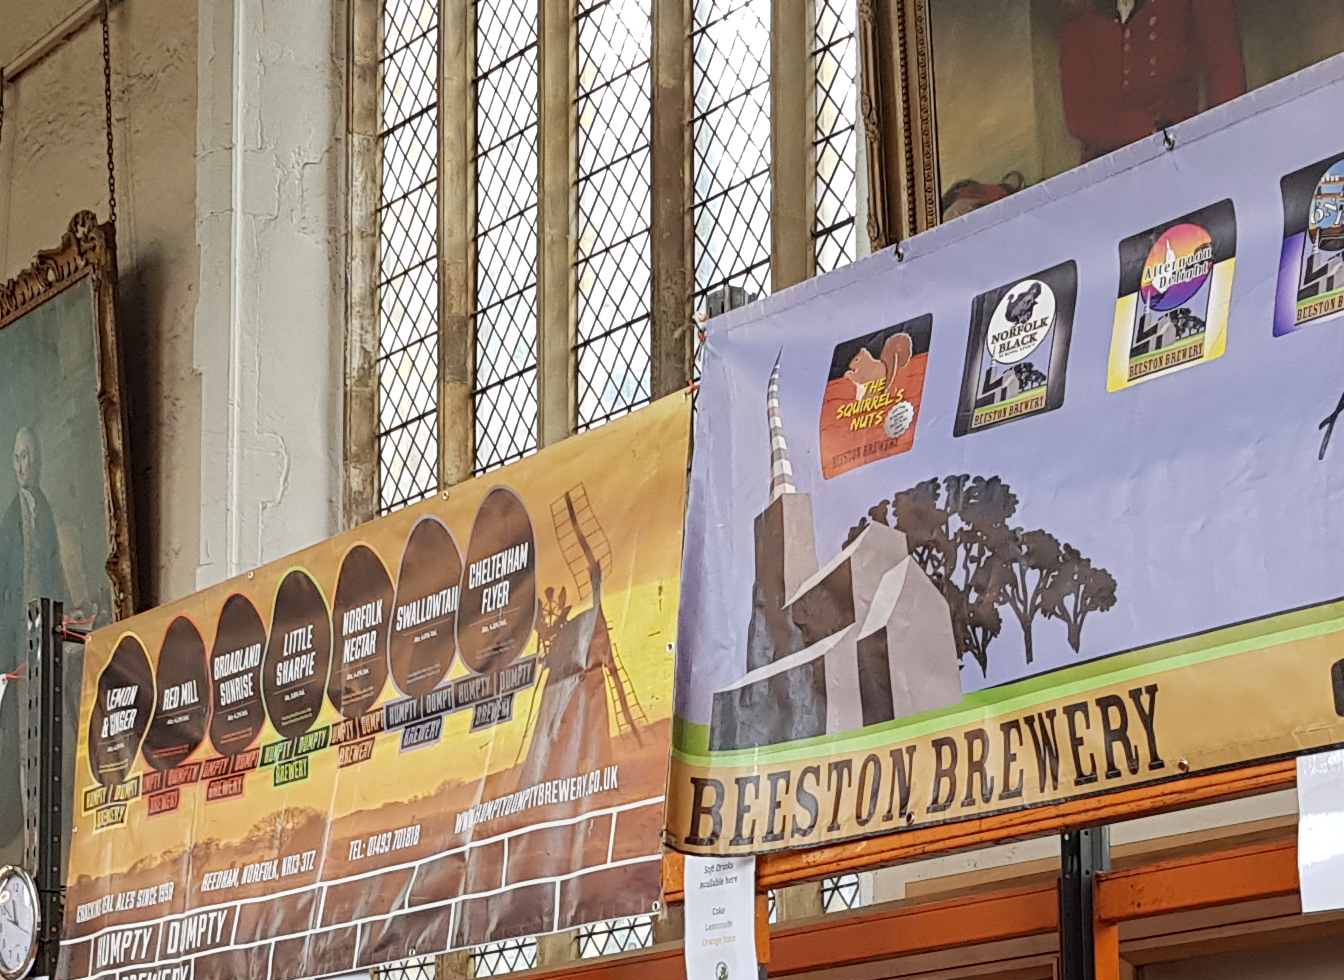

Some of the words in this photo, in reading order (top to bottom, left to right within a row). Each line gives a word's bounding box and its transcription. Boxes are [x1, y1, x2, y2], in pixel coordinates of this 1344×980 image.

[1310, 200, 1338, 225] ON
[1145, 246, 1212, 281] Afternoon
[1159, 262, 1210, 290] Delight
[1297, 297, 1336, 321] BEESTON
[992, 317, 1049, 343] NORFOLK
[999, 333, 1038, 352] BLACK
[1129, 354, 1163, 378] BEESTON
[1165, 343, 1203, 366] BREWERY
[864, 378, 887, 393] THE
[836, 388, 905, 419] SQUIRREL'S
[974, 406, 1007, 425] BEESTON
[1008, 396, 1044, 416] BREWERY
[850, 411, 883, 430] NUTS
[468, 542, 529, 590] CHELTENHAM
[481, 580, 510, 614] FLYER
[342, 599, 383, 636] NORFOLK
[283, 625, 314, 657] LITTLE
[343, 631, 377, 663] NECTAR
[214, 643, 261, 680] BROADLAND
[276, 651, 316, 686] SHARPIE
[107, 684, 138, 711] LEMON
[163, 686, 179, 711] RED
[181, 680, 199, 707] MILL
[220, 673, 255, 706] SUNRISE
[458, 673, 490, 702] HUMPTY
[389, 698, 418, 725] HUMPTY
[101, 722, 109, 738] &
[264, 738, 292, 767] HUMPTY
[684, 744, 917, 847] BEESTON
[930, 684, 1165, 818] BREWERY
[275, 758, 308, 786] BREWERY
[348, 842, 365, 861] TEL:
[367, 830, 391, 856] 01493
[392, 824, 421, 850] 701818
[201, 868, 239, 891] REEDHAM,
[242, 860, 278, 883] NORFOLK,
[96, 927, 153, 968] HUMPTY
[167, 911, 227, 954] DUMPTY
